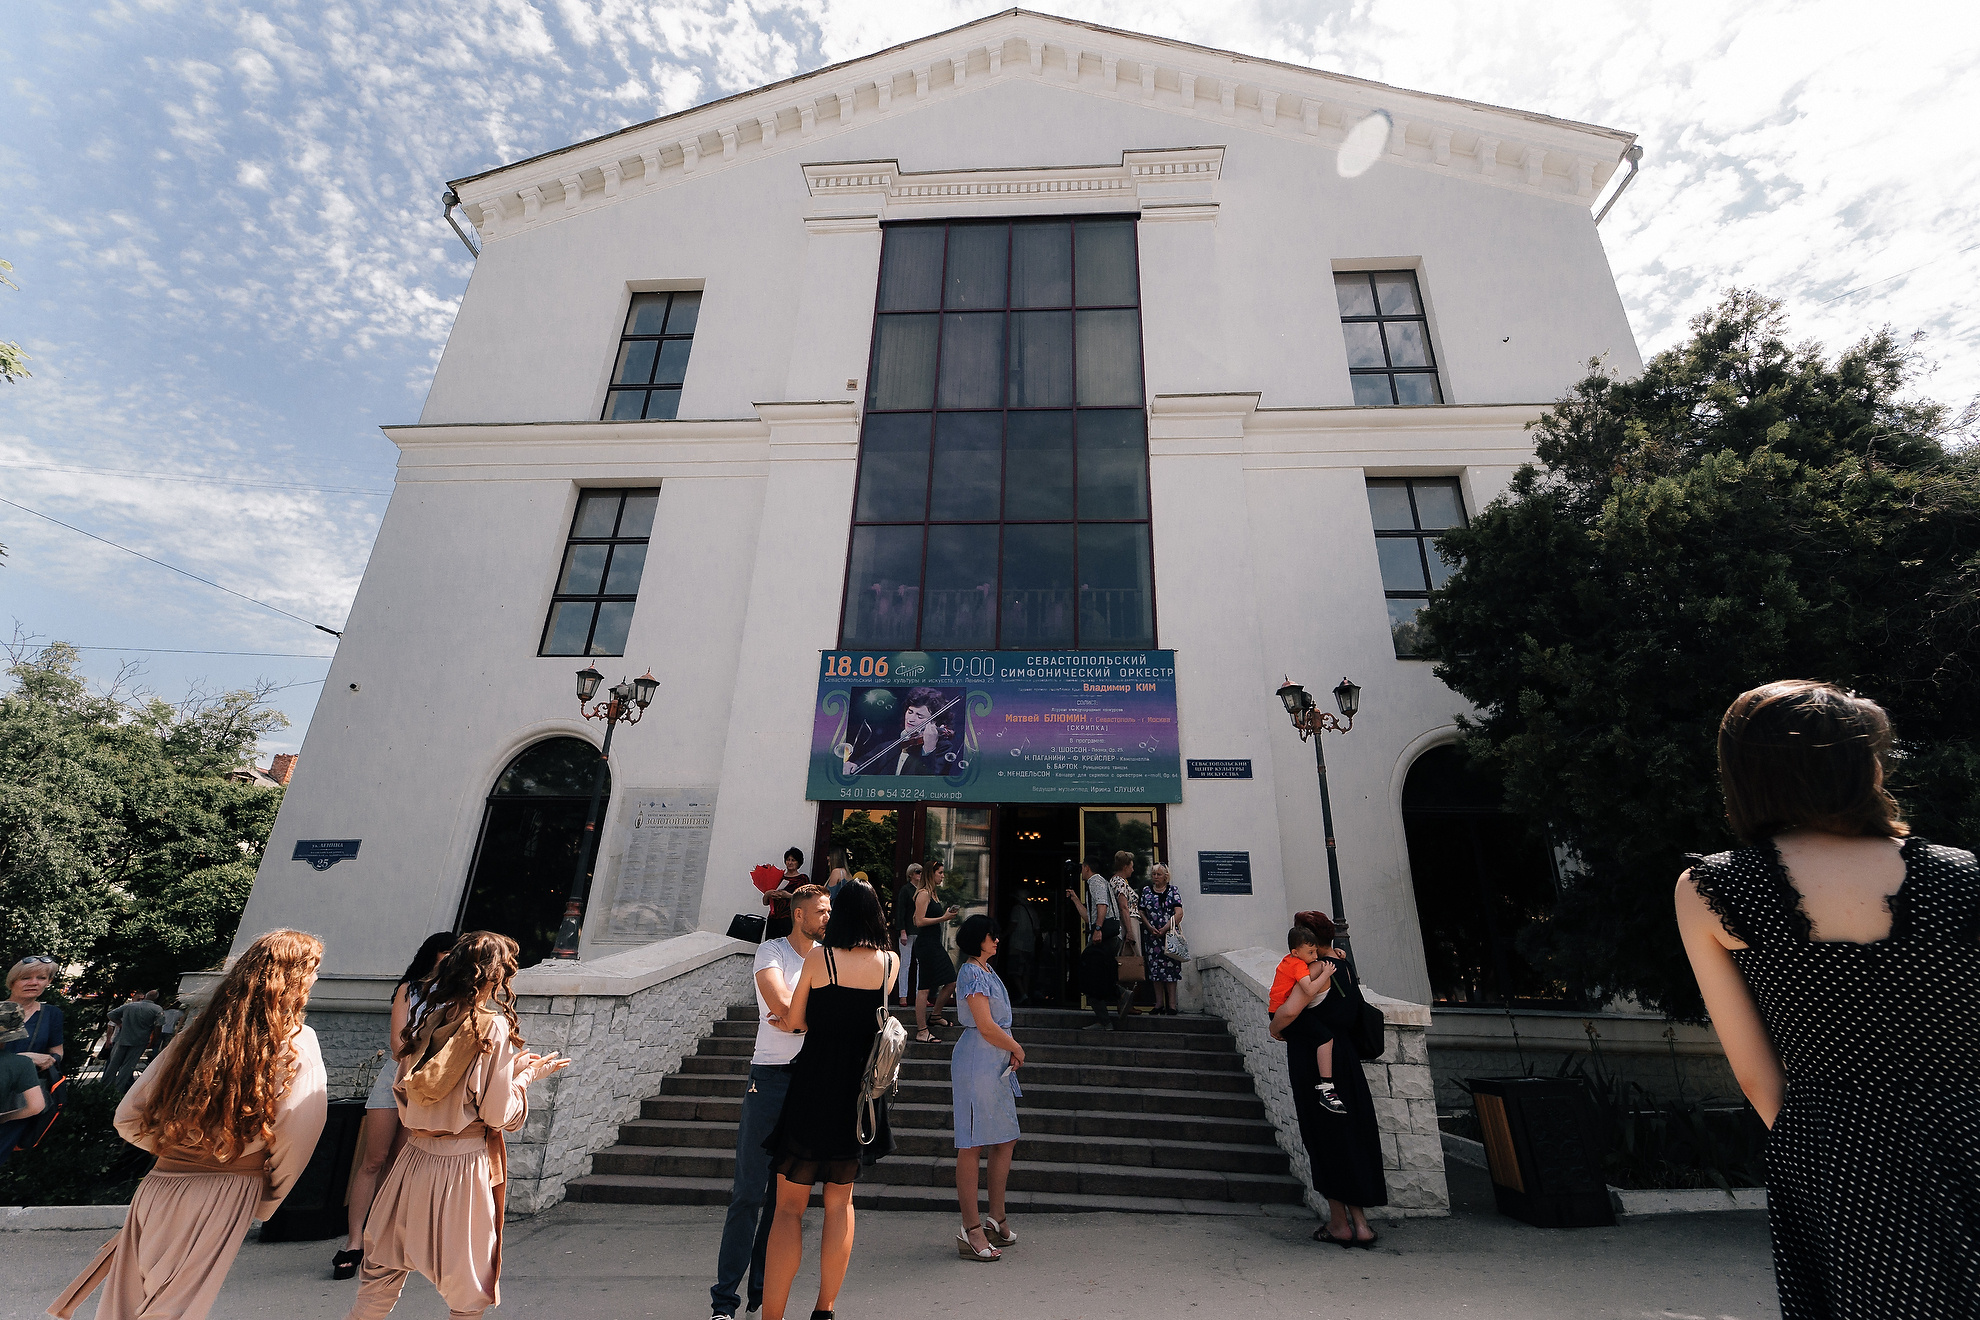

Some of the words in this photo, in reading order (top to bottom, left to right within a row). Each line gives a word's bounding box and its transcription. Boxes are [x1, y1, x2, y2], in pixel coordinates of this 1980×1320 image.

[1027, 654, 1147, 666] СЕВАСТОПОЛЬСКИЙ
[825, 656, 889, 677] 18.06
[940, 656, 995, 677] 19:00
[1000, 666, 1111, 678] СИМФОНИЧЕСКИЙ
[1119, 667, 1174, 678] ОРКЕСТР
[1083, 683, 1131, 693] Владимир
[1136, 683, 1156, 692] КИМ
[1005, 713, 1040, 723] Матвей
[1044, 713, 1087, 723] БЛЮМИН
[1081, 753, 1116, 762] КРЕЙСЛЕР
[1006, 770, 1051, 778] МЕНДЕЛЬСОН
[840, 788, 852, 798] 54
[854, 788, 863, 798] 01
[866, 788, 876, 798] 18
[886, 788, 897, 798] 54
[900, 788, 911, 798] 32
[316, 858, 329, 868] 25
